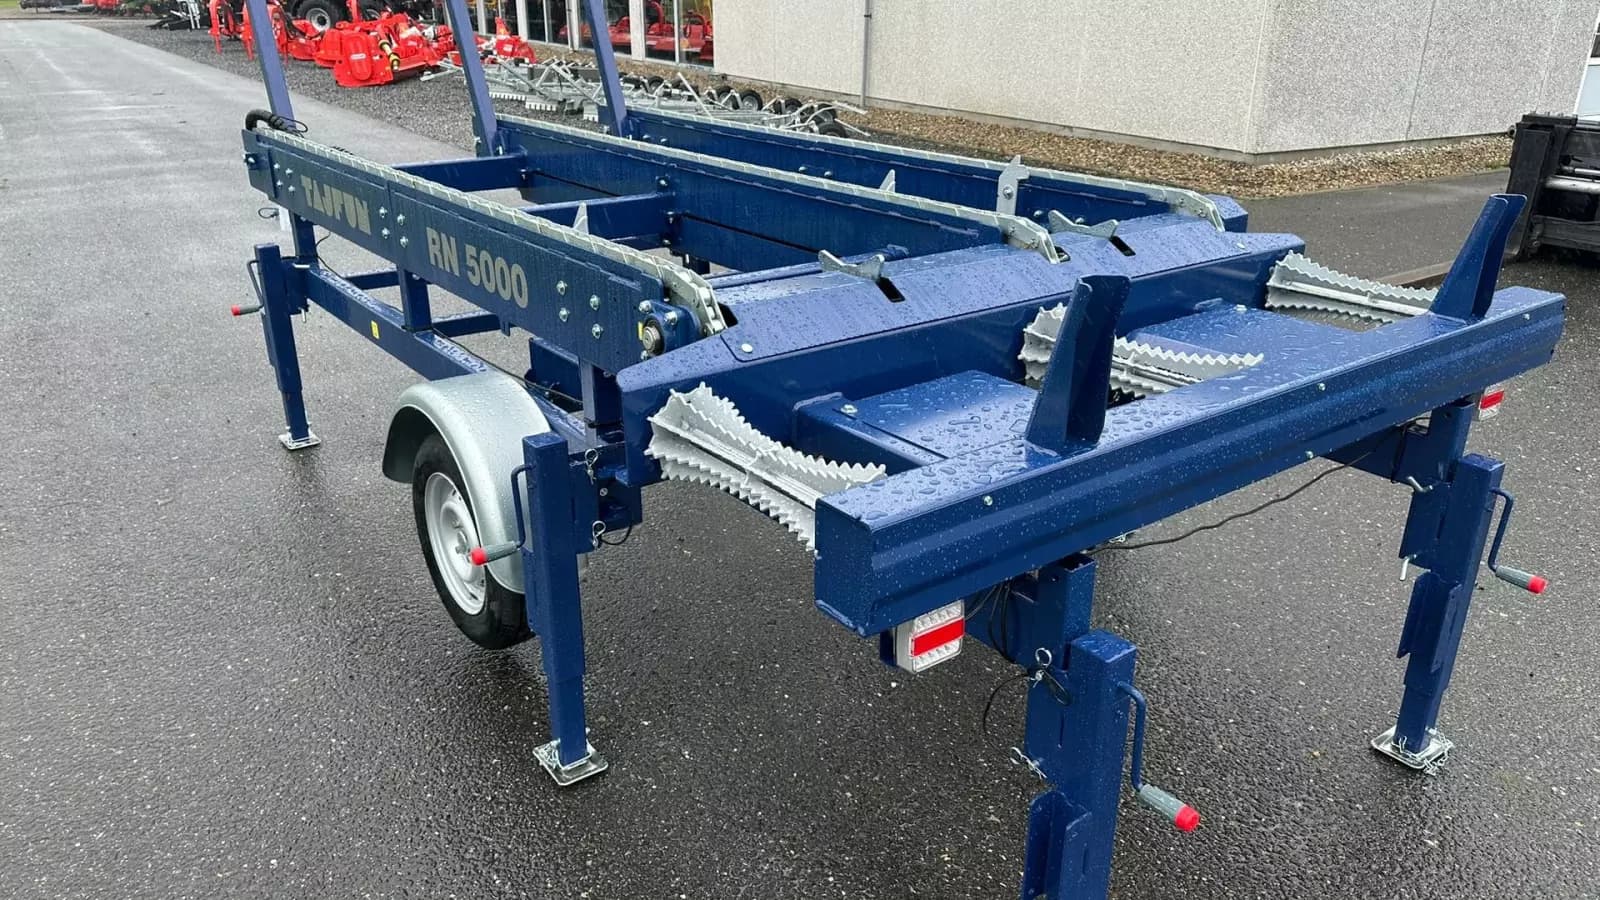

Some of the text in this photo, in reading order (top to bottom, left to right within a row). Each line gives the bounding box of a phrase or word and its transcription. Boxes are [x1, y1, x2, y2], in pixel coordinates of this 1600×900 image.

[300, 174, 372, 235] TAJFUN
[426, 227, 529, 309] RN 5000
